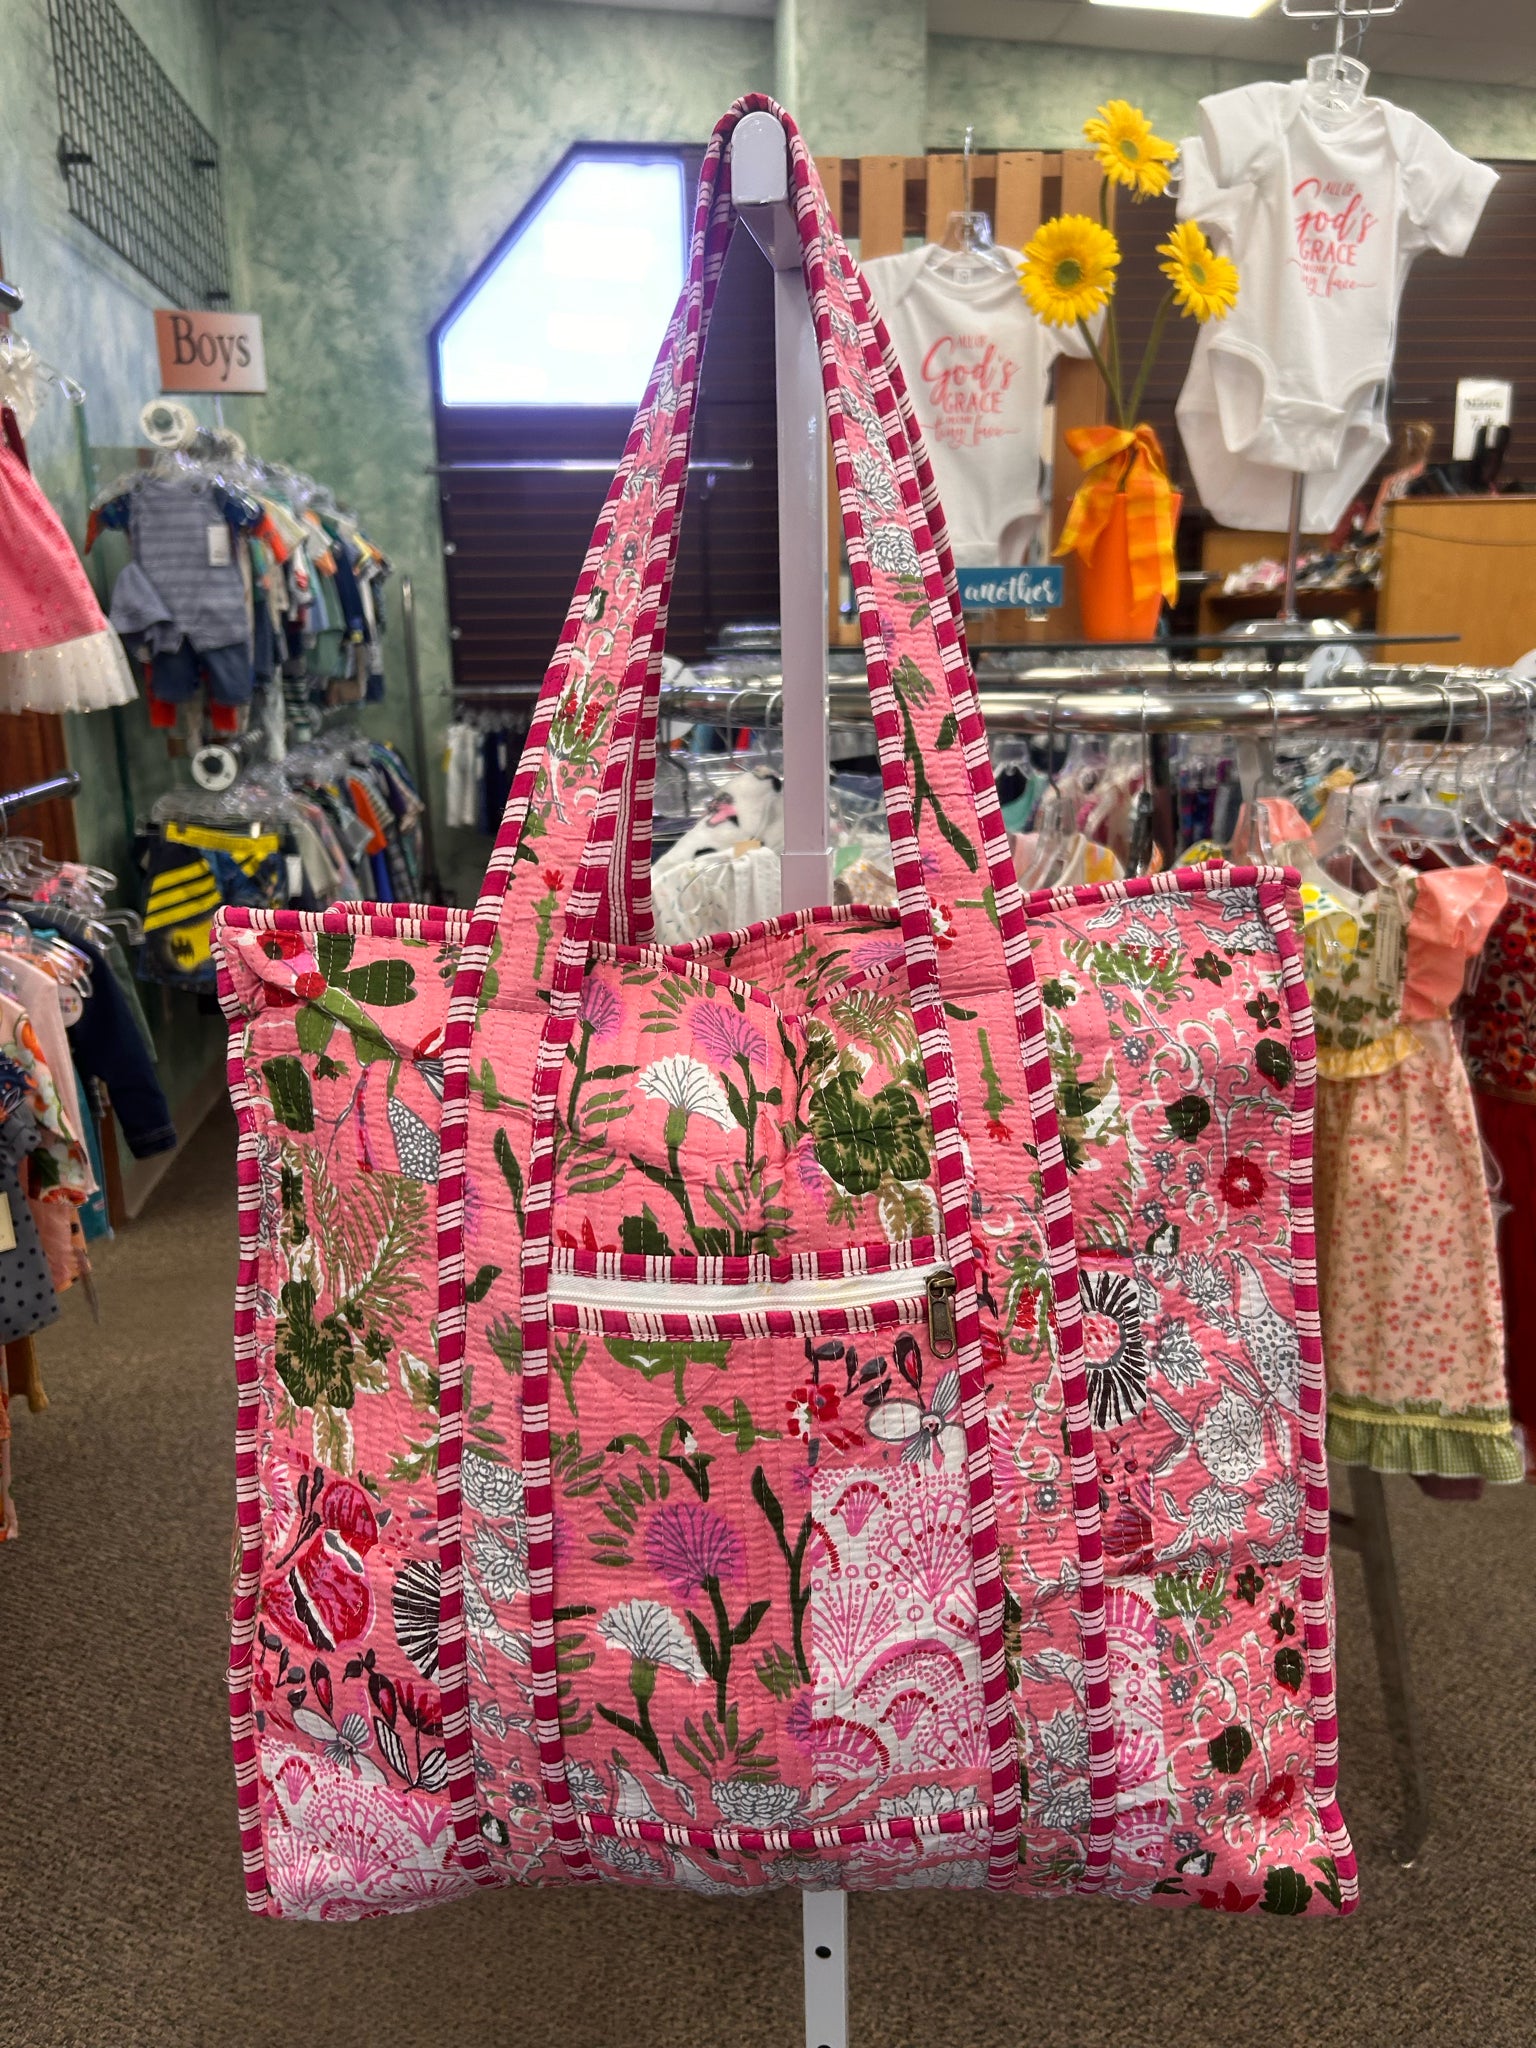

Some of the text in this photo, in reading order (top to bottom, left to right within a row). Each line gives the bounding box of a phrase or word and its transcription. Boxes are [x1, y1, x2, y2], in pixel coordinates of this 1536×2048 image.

[1299, 239, 1356, 266] GRACE
[169, 314, 251, 382] Boys
[921, 335, 1021, 405] God's
[943, 392, 1003, 414] GRACE
[964, 570, 1057, 605] another
